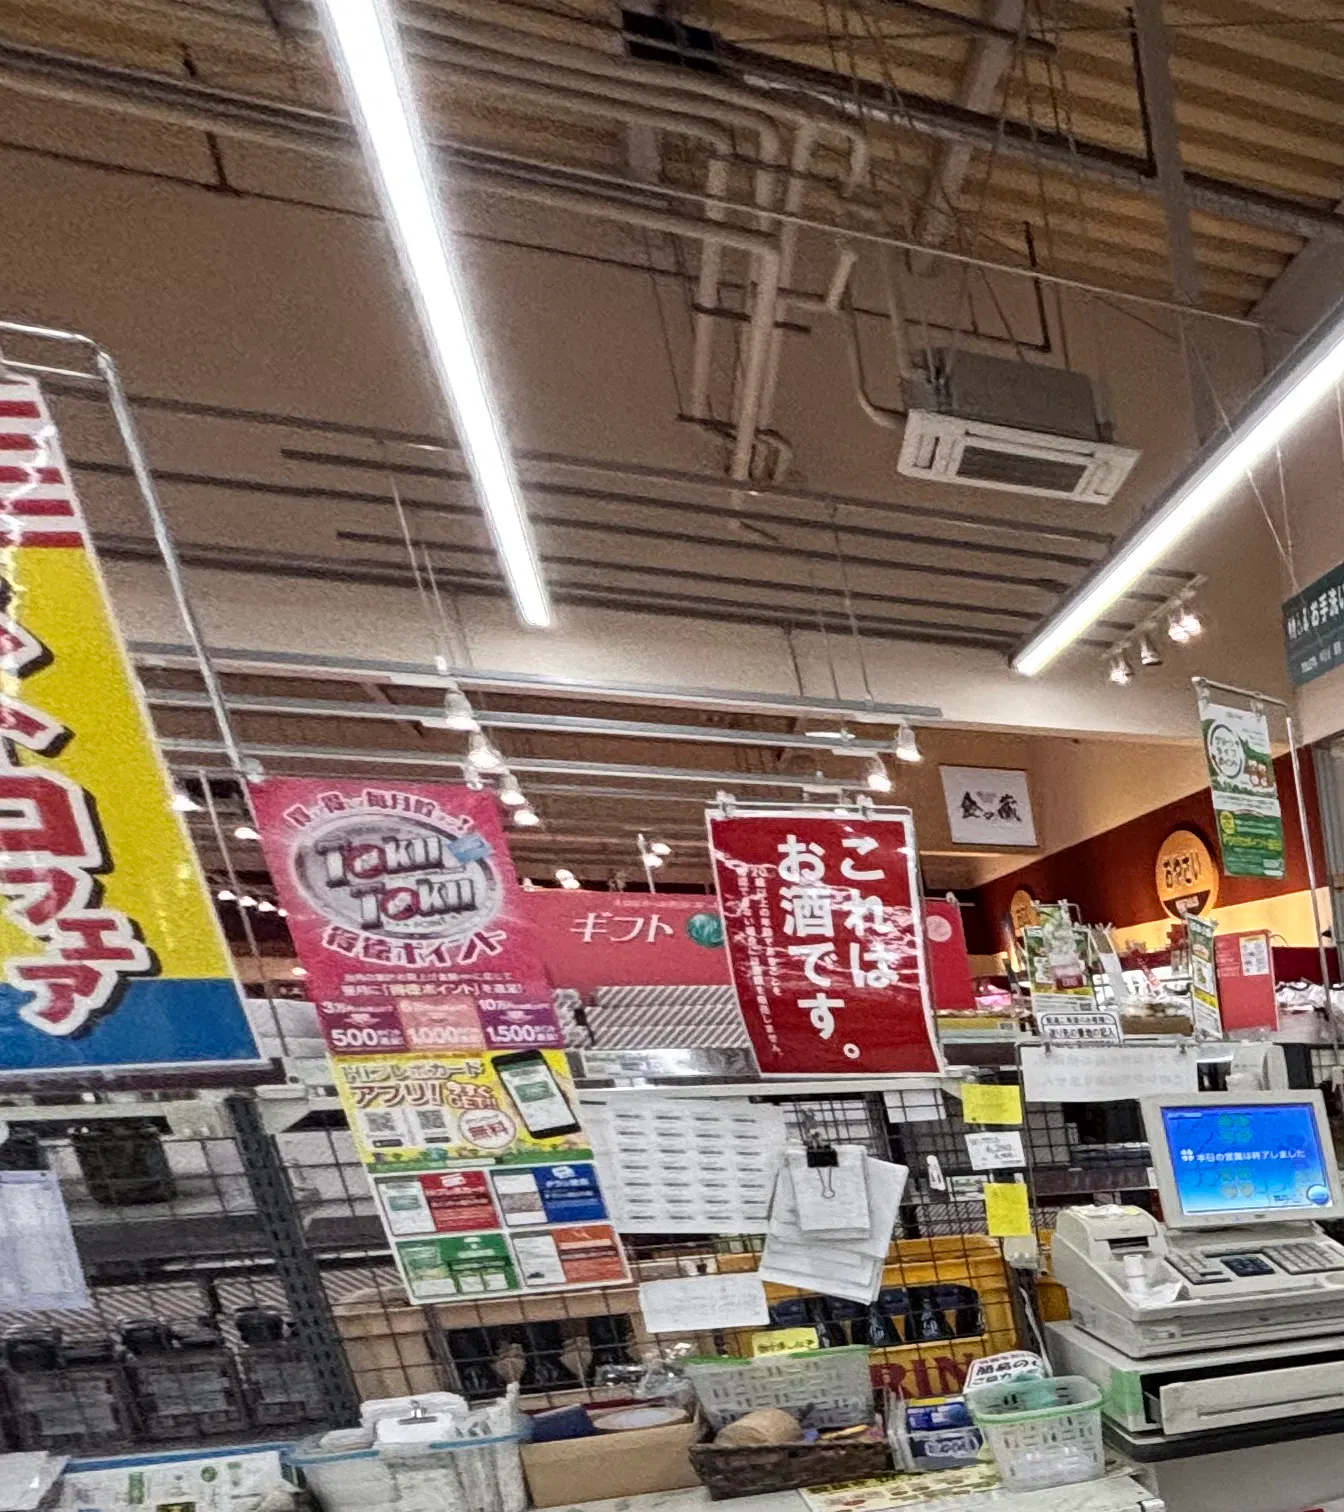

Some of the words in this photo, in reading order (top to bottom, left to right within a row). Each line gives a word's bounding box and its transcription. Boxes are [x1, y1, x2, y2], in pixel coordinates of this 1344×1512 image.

[572, 912, 674, 945] ギフト
[840, 835, 901, 989] これは
[331, 1029, 379, 1047] 500
